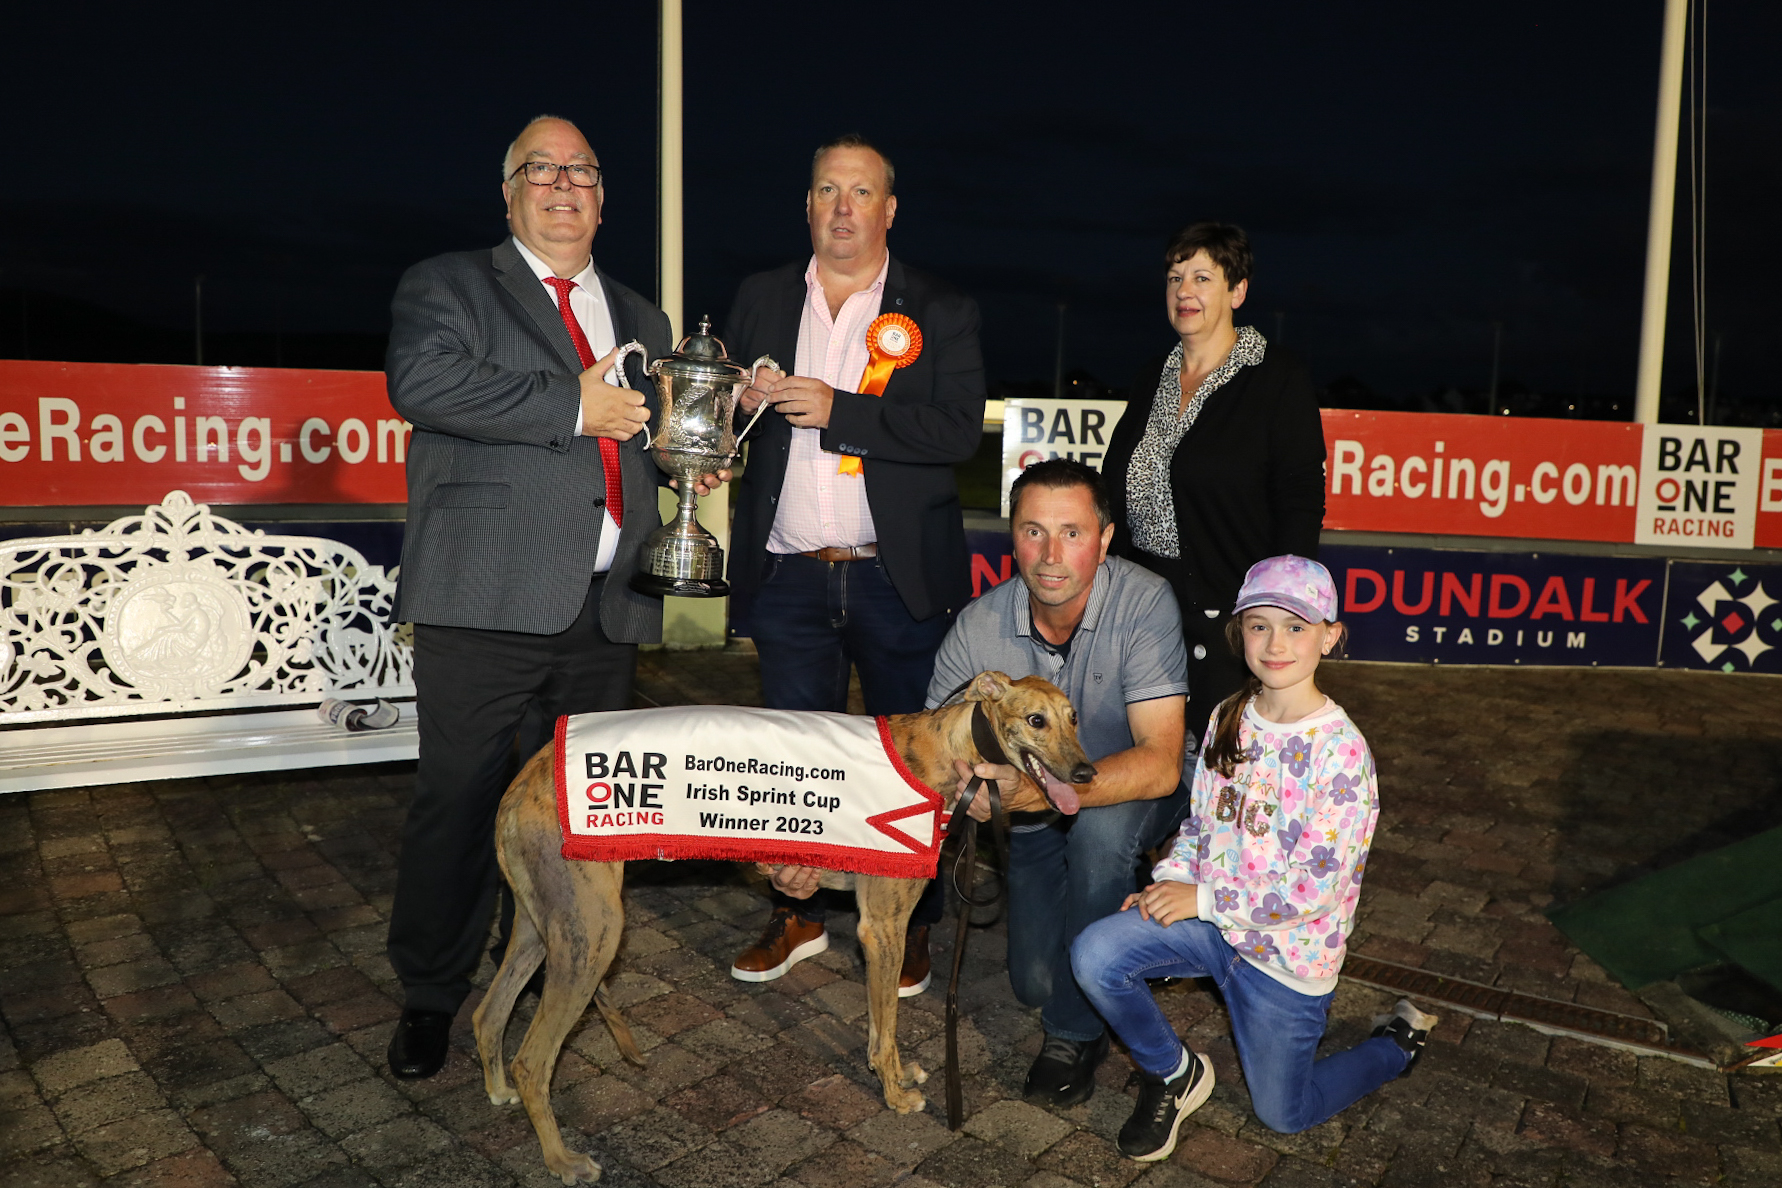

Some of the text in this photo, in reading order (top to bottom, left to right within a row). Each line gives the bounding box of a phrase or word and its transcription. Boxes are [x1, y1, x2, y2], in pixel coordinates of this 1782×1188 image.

[1021, 407, 1105, 445] BAR
[1658, 437, 1741, 474] BAR
[1328, 439, 1637, 518] Racing.com
[1655, 478, 1736, 514] ONE
[1653, 518, 1734, 538] RACING
[1343, 568, 1652, 625] DUNDALK
[1405, 626, 1587, 649] STADIUM
[585, 751, 668, 780] BAR
[685, 755, 846, 782] BarOneRacing.com
[586, 782, 664, 810] ONE
[686, 783, 840, 813] Irish Sprint Cup
[586, 811, 664, 829] RACING
[699, 812, 824, 835] Winner 2023
